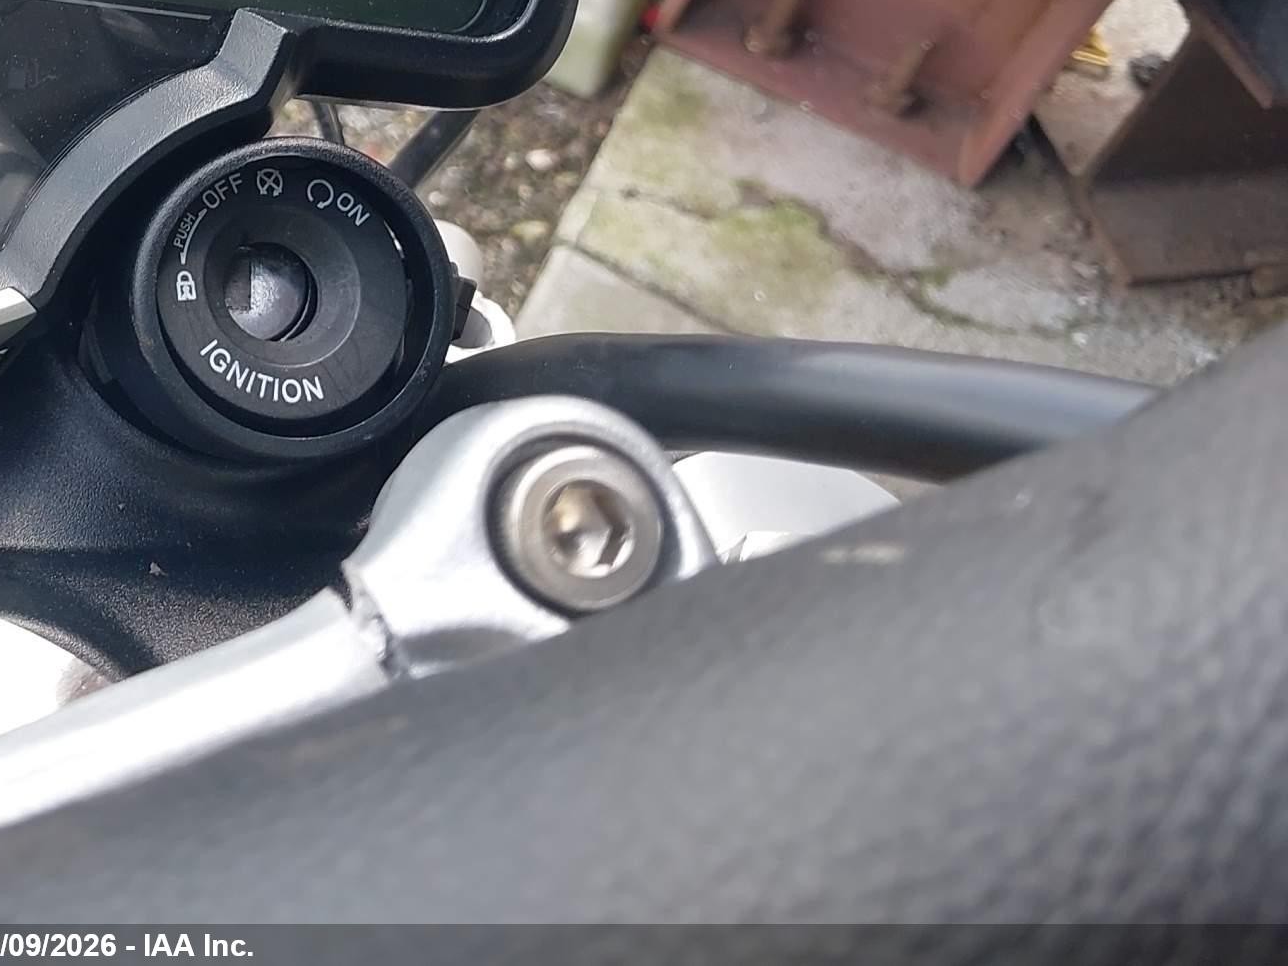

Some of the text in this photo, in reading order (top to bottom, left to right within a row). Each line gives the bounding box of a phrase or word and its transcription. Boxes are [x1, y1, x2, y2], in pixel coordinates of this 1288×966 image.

[202, 172, 243, 209] OFF
[337, 192, 370, 227] ON
[173, 212, 196, 249] PUSH
[199, 339, 324, 403] IGNITION
